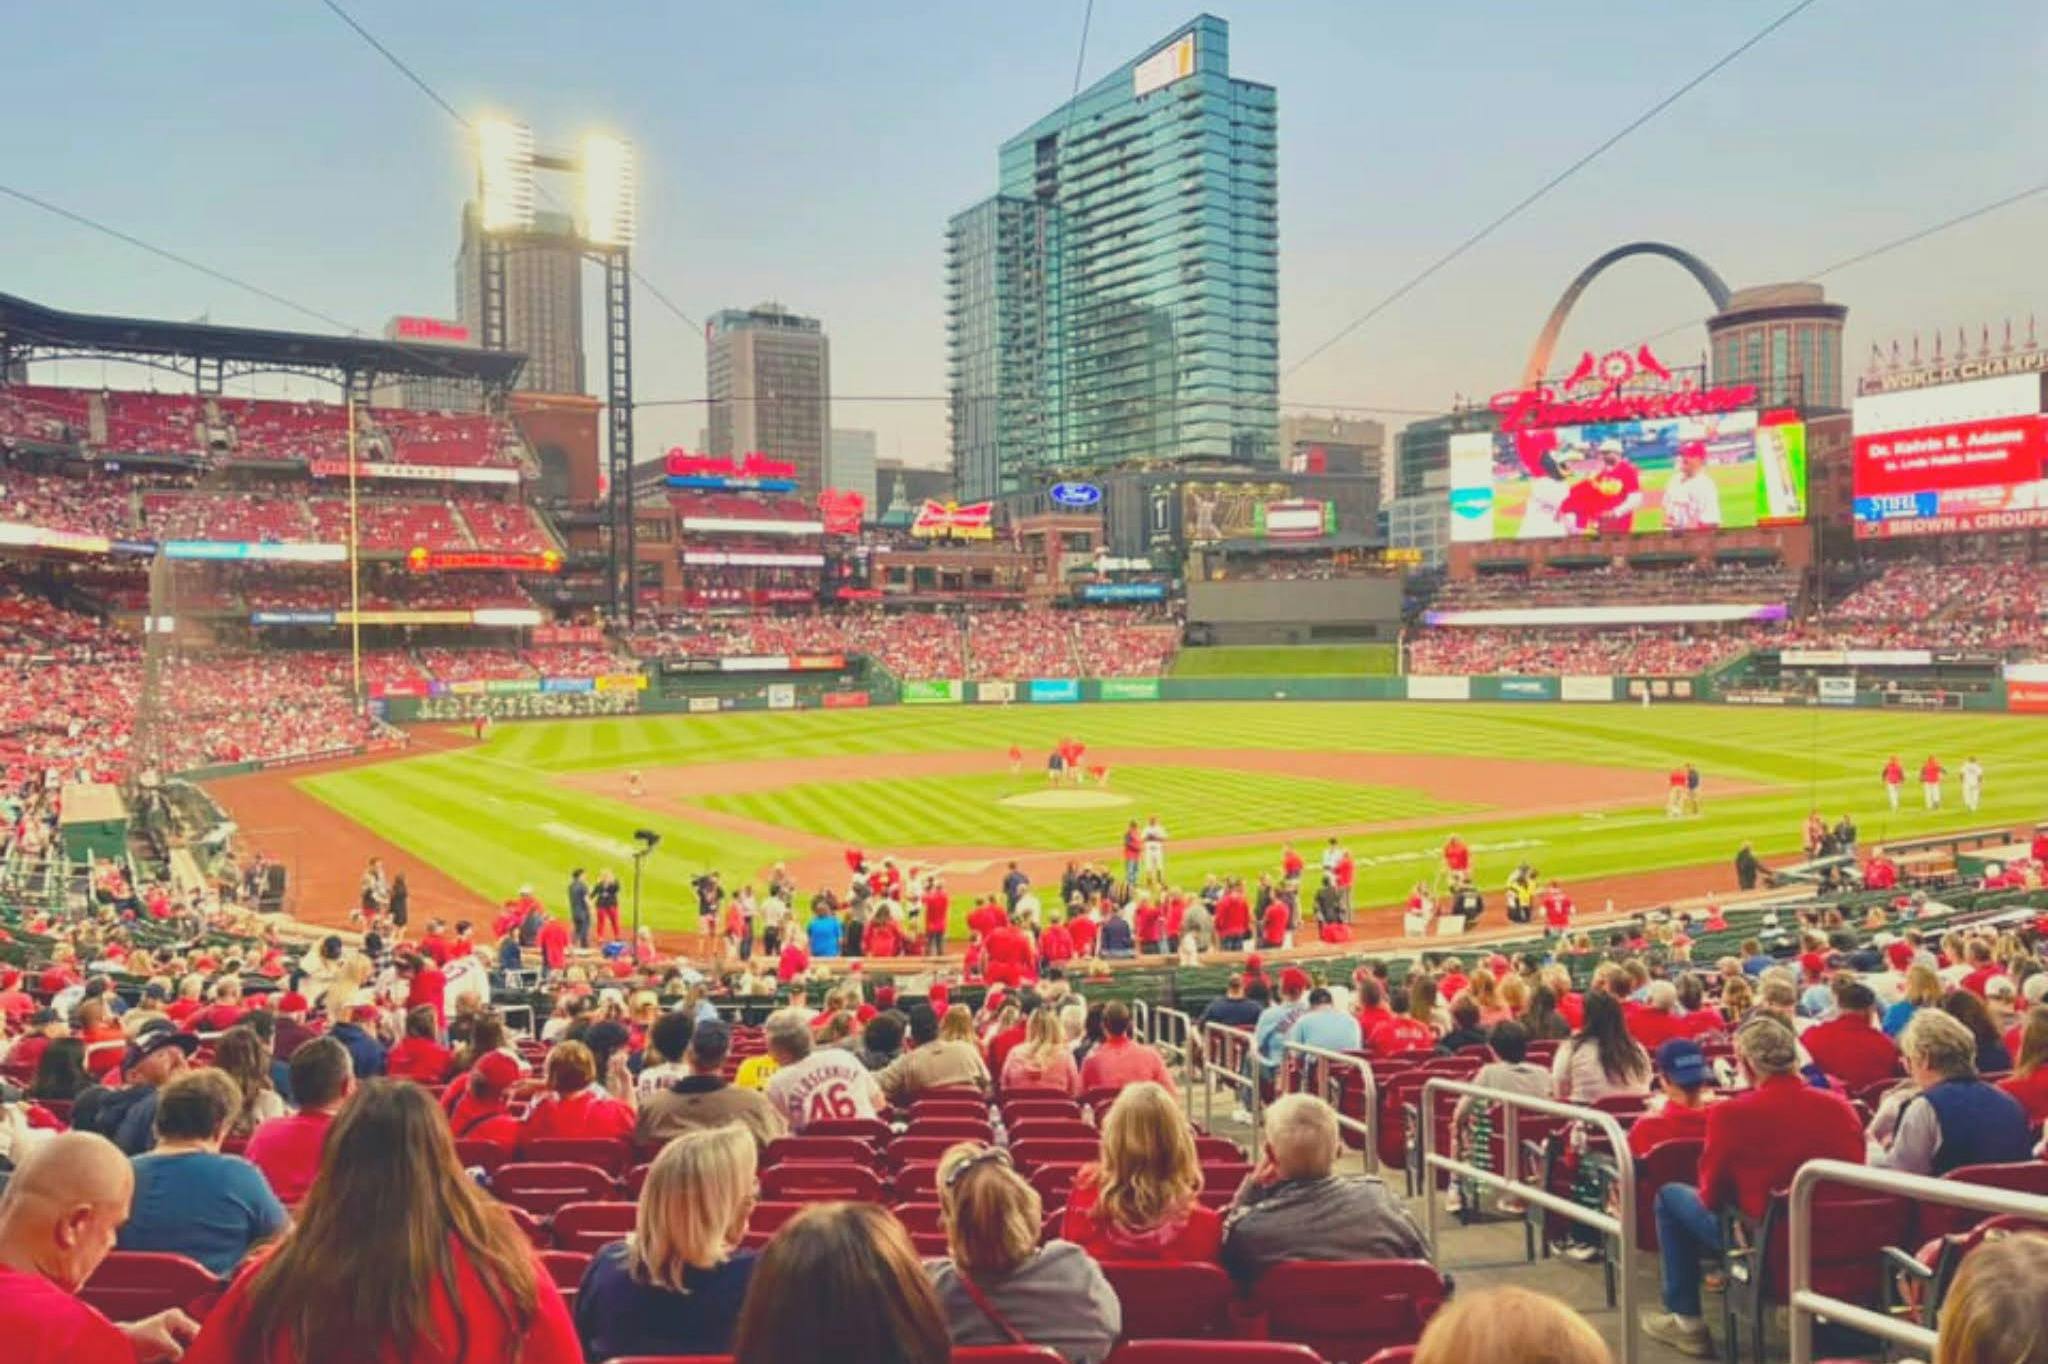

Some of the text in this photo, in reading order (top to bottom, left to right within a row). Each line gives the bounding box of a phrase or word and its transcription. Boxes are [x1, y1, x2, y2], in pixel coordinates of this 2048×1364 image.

[1882, 366, 1953, 390] WORLD
[1889, 515, 1955, 536] BROWN
[810, 1083, 858, 1120] 46
